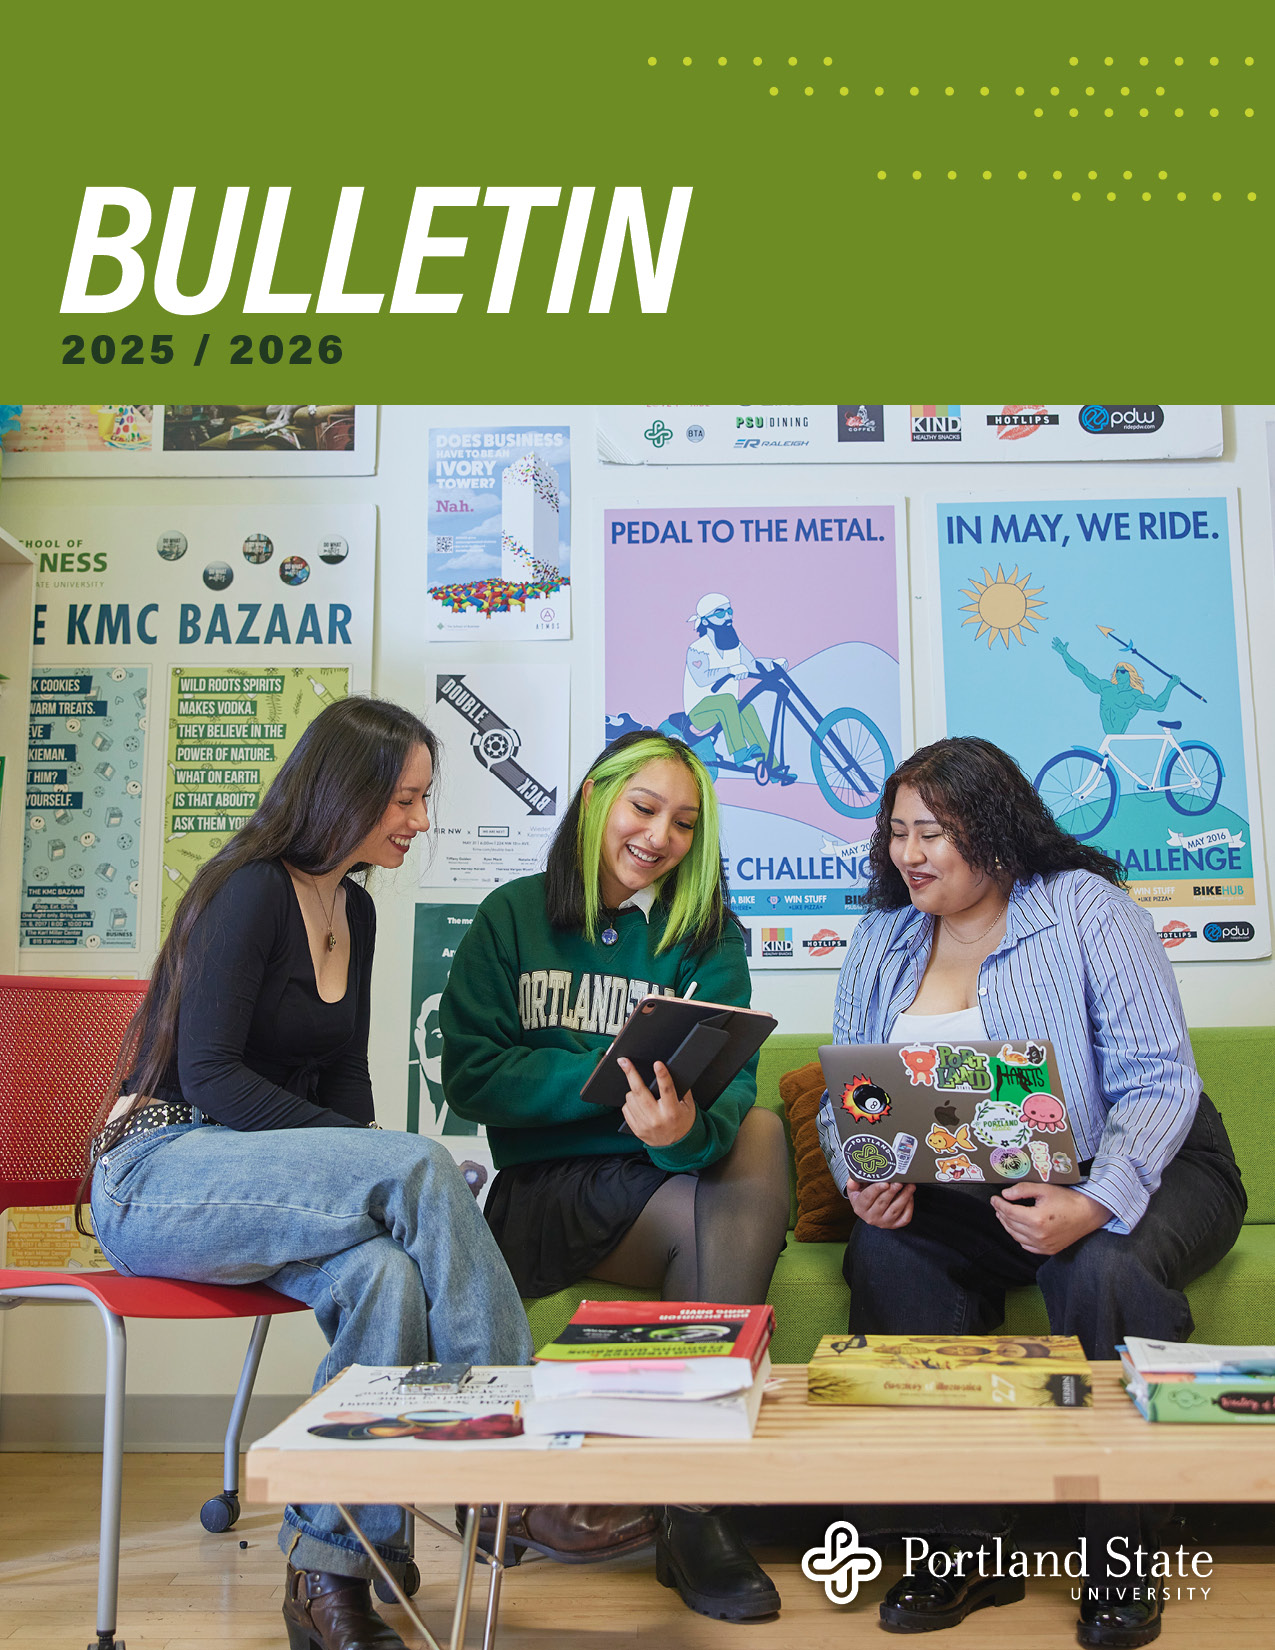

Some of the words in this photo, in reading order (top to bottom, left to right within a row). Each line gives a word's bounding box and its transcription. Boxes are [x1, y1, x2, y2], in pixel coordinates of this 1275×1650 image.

[736, 416, 764, 428] PSU
[769, 416, 809, 427] DINING
[912, 417, 961, 432] KIND
[995, 416, 1050, 424] HOTLIPS
[1111, 408, 1155, 428] pdw
[436, 434, 481, 448] DOES
[483, 433, 563, 447] BUSINESS
[436, 449, 464, 458] HAVE
[465, 449, 478, 457] TO
[481, 449, 493, 457] BE
[494, 449, 509, 457] AN
[436, 460, 496, 476] IVORY
[436, 478, 495, 489] TOWER?
[436, 500, 474, 512] Nah.
[611, 521, 692, 544] PEDAL
[698, 520, 735, 543] TO
[740, 519, 788, 542] THE
[795, 518, 885, 542] METAL.
[947, 515, 982, 544] IN
[991, 513, 1070, 547] MAY,
[1076, 512, 1131, 542] WE
[1139, 511, 1219, 540] RIDE.
[67, 540, 83, 548] OF
[67, 604, 159, 645] KMC
[179, 604, 352, 645] BAZAAR
[41, 679, 80, 692] COOKIES
[181, 679, 206, 691] WILD
[208, 679, 241, 691] ROOTS
[243, 678, 281, 691] SPIRITS
[179, 701, 215, 714] MAKES
[218, 701, 255, 714] VODKA.
[441, 678, 490, 724] DOUBLE
[59, 702, 95, 714] TREATS.
[179, 724, 205, 737] THEY
[207, 724, 248, 737] BELIEVE
[251, 724, 261, 737] IN
[263, 724, 283, 737] THE
[28, 748, 67, 760] KIEMAN.
[177, 748, 213, 761] POWER
[215, 748, 229, 760] OF
[230, 748, 273, 760] NATURE.
[34, 772, 58, 783] HIM?
[176, 771, 206, 783] WHAT
[208, 771, 222, 783] ON
[224, 771, 258, 783] EARTH
[26, 794, 73, 806] YOURSELF.
[175, 793, 185, 807] IS
[187, 793, 213, 806] THAT
[215, 793, 256, 806] ABOUT?
[516, 777, 551, 812] BACK
[174, 817, 195, 830] ASK
[197, 817, 226, 830] THEM
[1187, 838, 1205, 849] MAY
[1207, 832, 1226, 844] 2016
[841, 846, 859, 858] MAY
[1153, 886, 1175, 895] STUFF
[1193, 885, 1244, 896] BIKEHUB
[738, 896, 755, 904] BIKE
[784, 896, 803, 904] WIN
[804, 895, 827, 903] STUFF
[1222, 925, 1250, 939] pdw
[763, 941, 793, 951] KIND
[937, 1046, 987, 1070] PORT
[936, 1066, 991, 1090] LAND
[983, 1120, 1018, 1128] PORTLAND
[851, 1138, 891, 1154] PORTLAND
[858, 1170, 880, 1179] STATE
